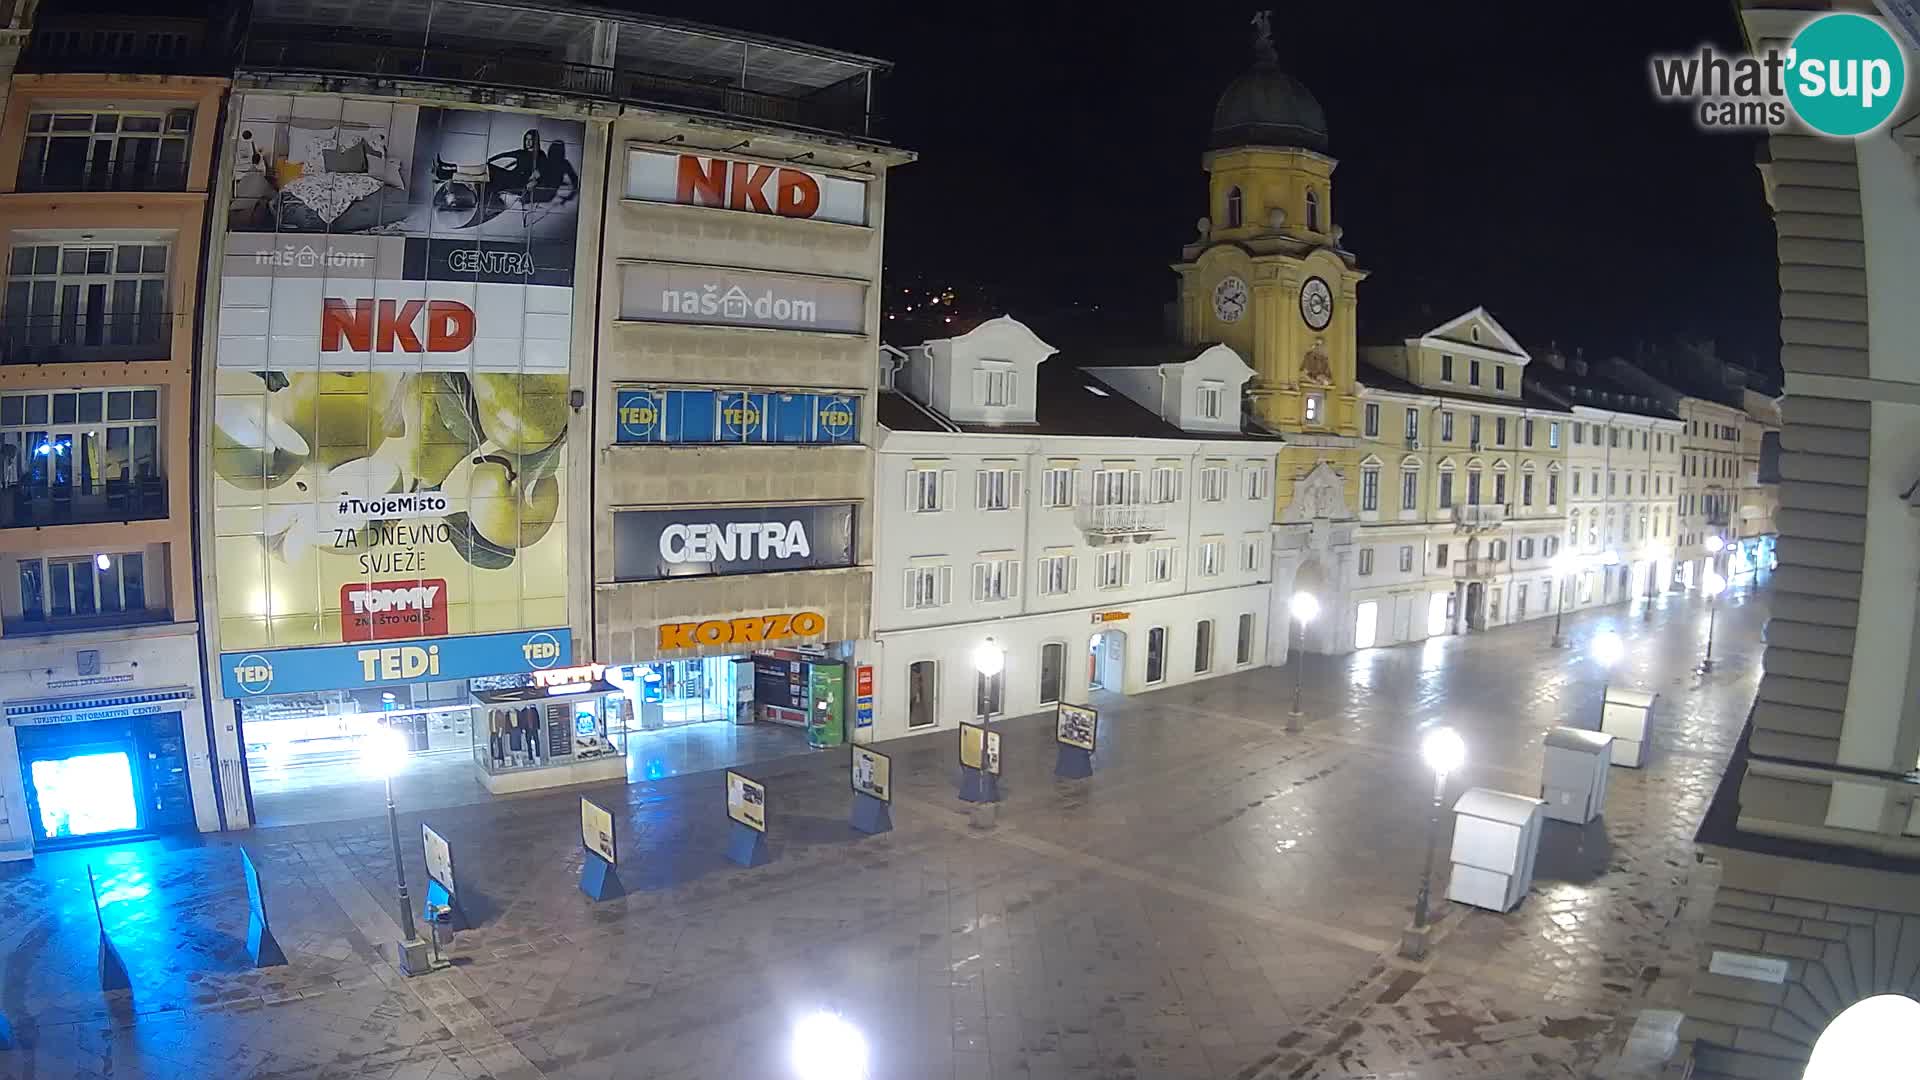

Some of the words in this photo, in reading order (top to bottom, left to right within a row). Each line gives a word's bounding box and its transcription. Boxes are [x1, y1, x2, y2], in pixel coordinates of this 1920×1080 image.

[677, 154, 820, 218] NKD
[255, 246, 294, 267] naš
[324, 248, 366, 268] dom
[448, 249, 535, 275] CENTRA
[662, 284, 718, 315] naš
[754, 289, 816, 322] dom
[321, 297, 477, 353] NKD
[620, 408, 658, 424] TEDi
[723, 408, 760, 425] TEDi
[820, 410, 853, 425] TEDi
[339, 496, 446, 516] #TvojeMisto
[334, 528, 358, 548] ZA
[366, 523, 450, 547] DNEVNO
[659, 520, 811, 563] CENTRA
[360, 547, 427, 574] SVJEŽE
[349, 586, 439, 613] TOMMY
[660, 612, 825, 650] KORZO
[358, 646, 440, 682] TEDi
[522, 643, 560, 659] TEDi
[234, 665, 273, 683] TEDi
